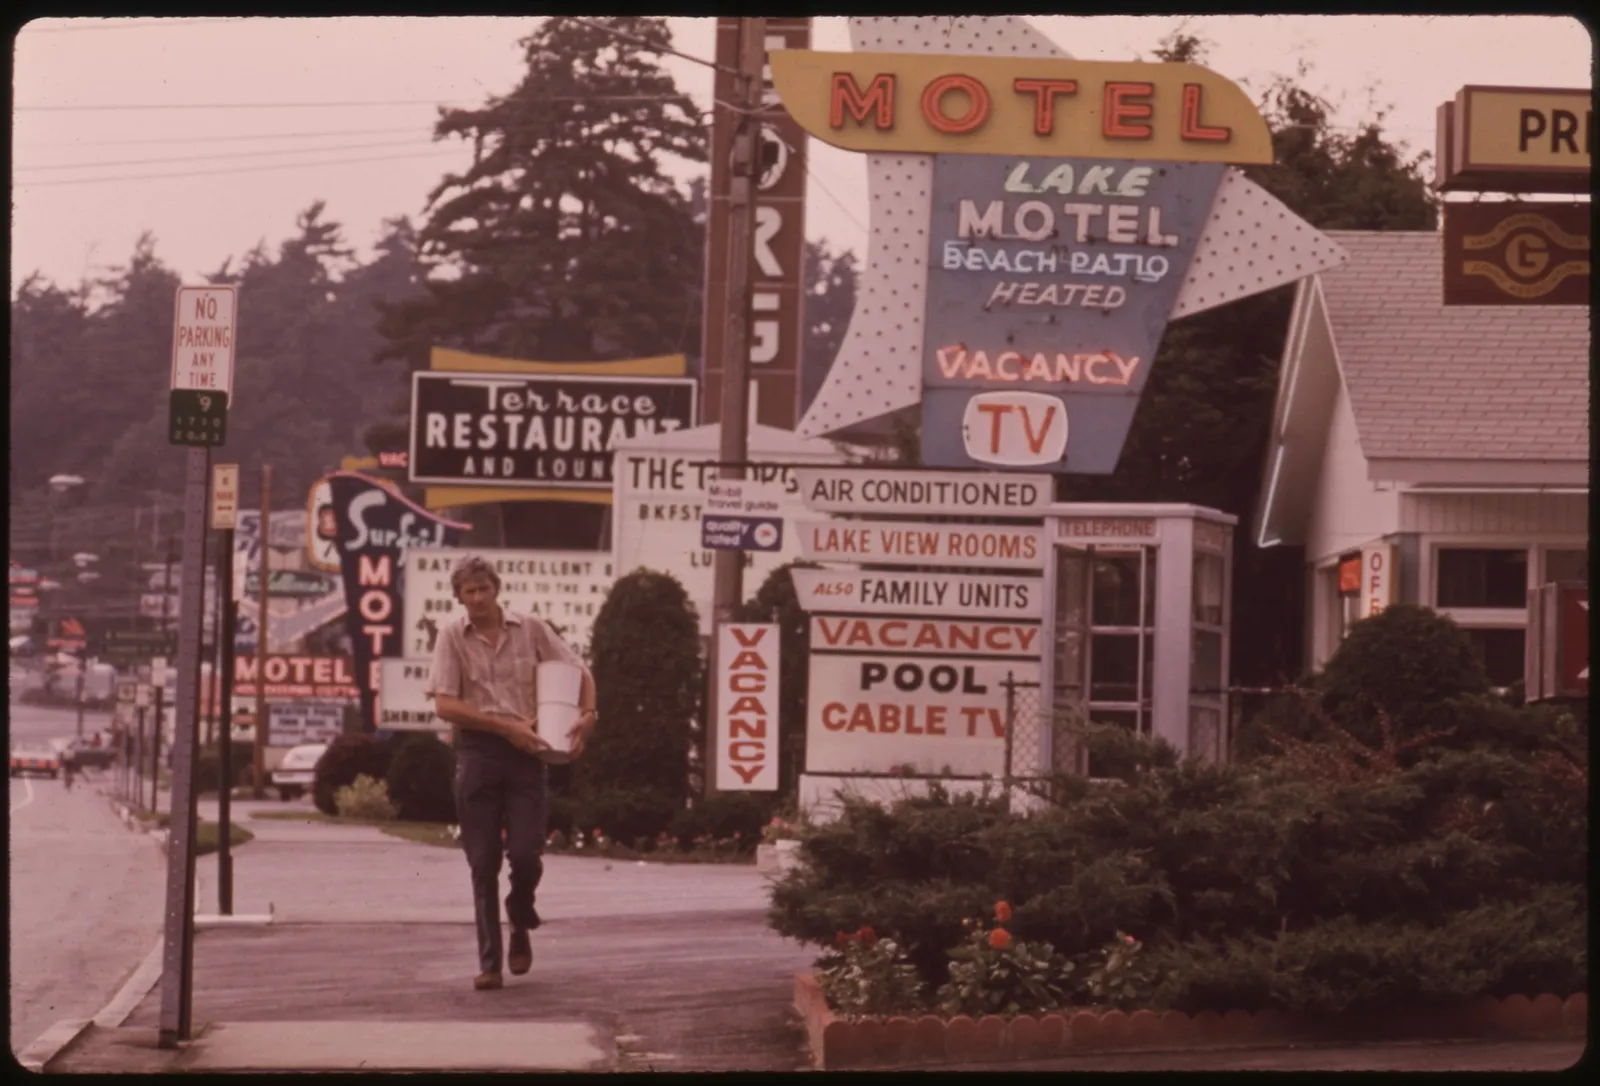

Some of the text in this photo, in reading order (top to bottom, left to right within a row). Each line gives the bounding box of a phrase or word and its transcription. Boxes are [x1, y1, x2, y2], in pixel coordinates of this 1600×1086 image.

[829, 72, 1232, 143] MOTEL
[1003, 161, 1154, 197] LAKE
[957, 199, 1179, 247] MOTEL
[942, 241, 1170, 283] BEACH PATIO
[195, 297, 218, 320] NO
[986, 281, 1127, 309] HEATED
[179, 325, 230, 348] PARKING
[192, 352, 216, 368] ANY
[936, 345, 1142, 385] VACANCY
[189, 372, 217, 388] TIME
[200, 395, 212, 413] 9
[450, 379, 657, 415] Terrace
[977, 403, 1056, 455] TV
[463, 456, 615, 479] AND LOUN
[628, 457, 685, 490] THE
[707, 498, 779, 512] travel guide
[811, 478, 1038, 507] AIR CONDITIONED
[638, 503, 702, 521] BKFST
[705, 520, 750, 536] quality
[705, 533, 741, 547] rated
[1064, 520, 1155, 537] TELEPHONE
[813, 527, 1038, 560] LAKE VIEW ROOMS
[418, 557, 452, 573] RAT
[497, 558, 593, 576] EXCELLENT
[690, 551, 754, 569] LUH
[813, 578, 1029, 609] ALSO FAMILY UNITS
[1370, 551, 1383, 617] OFF
[817, 617, 1038, 651] VACANCY
[234, 655, 352, 684] MOTEL
[859, 661, 988, 695] POOL
[728, 628, 768, 784] VACANCY
[821, 701, 1008, 738] CABLE TV
